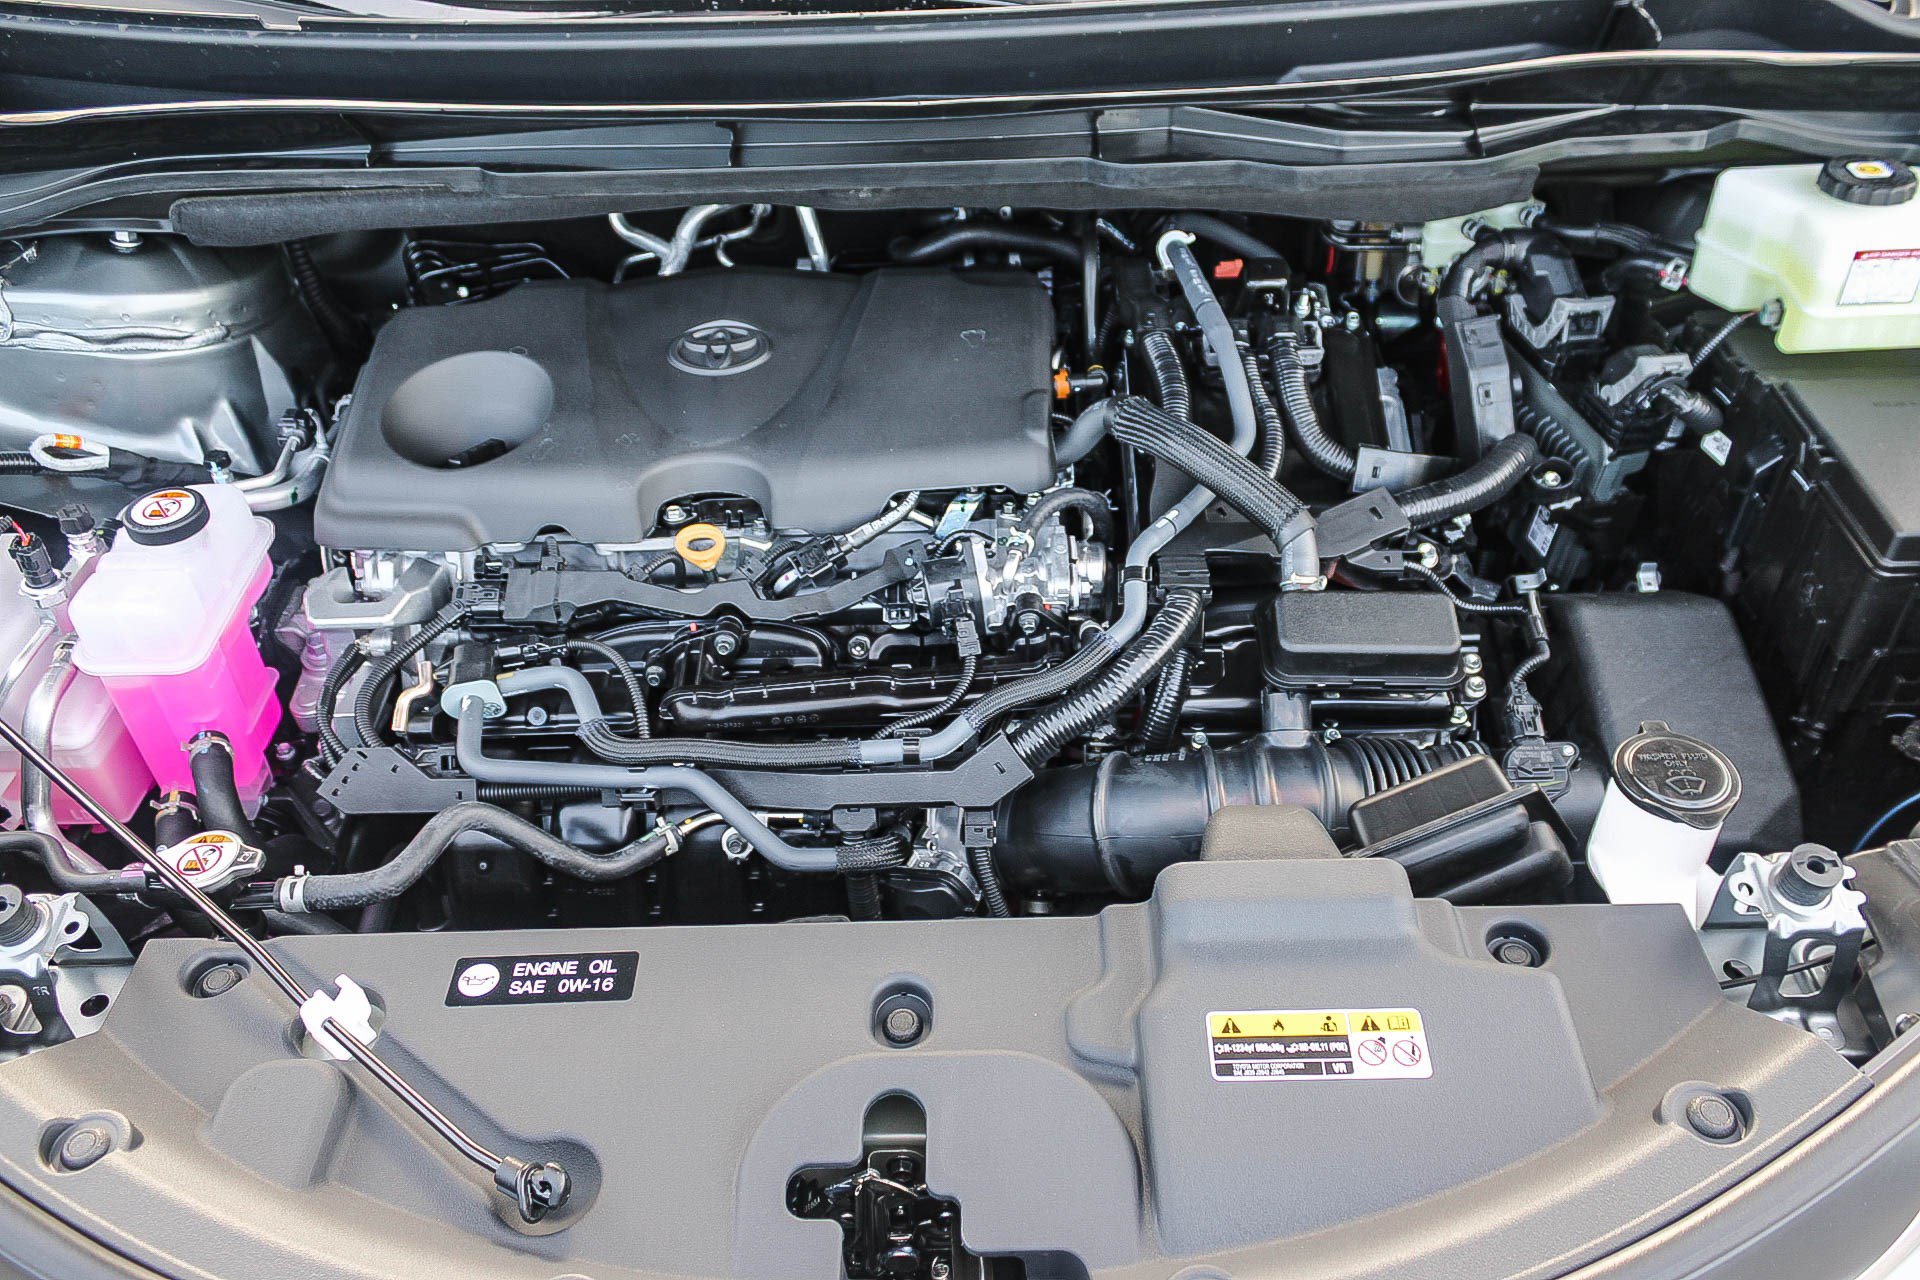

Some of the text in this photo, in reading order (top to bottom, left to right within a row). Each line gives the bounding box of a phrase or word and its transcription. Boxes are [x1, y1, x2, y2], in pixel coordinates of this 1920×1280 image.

[513, 959, 618, 977] ENGINE OIL
[508, 977, 614, 995] SAE 0W-16
